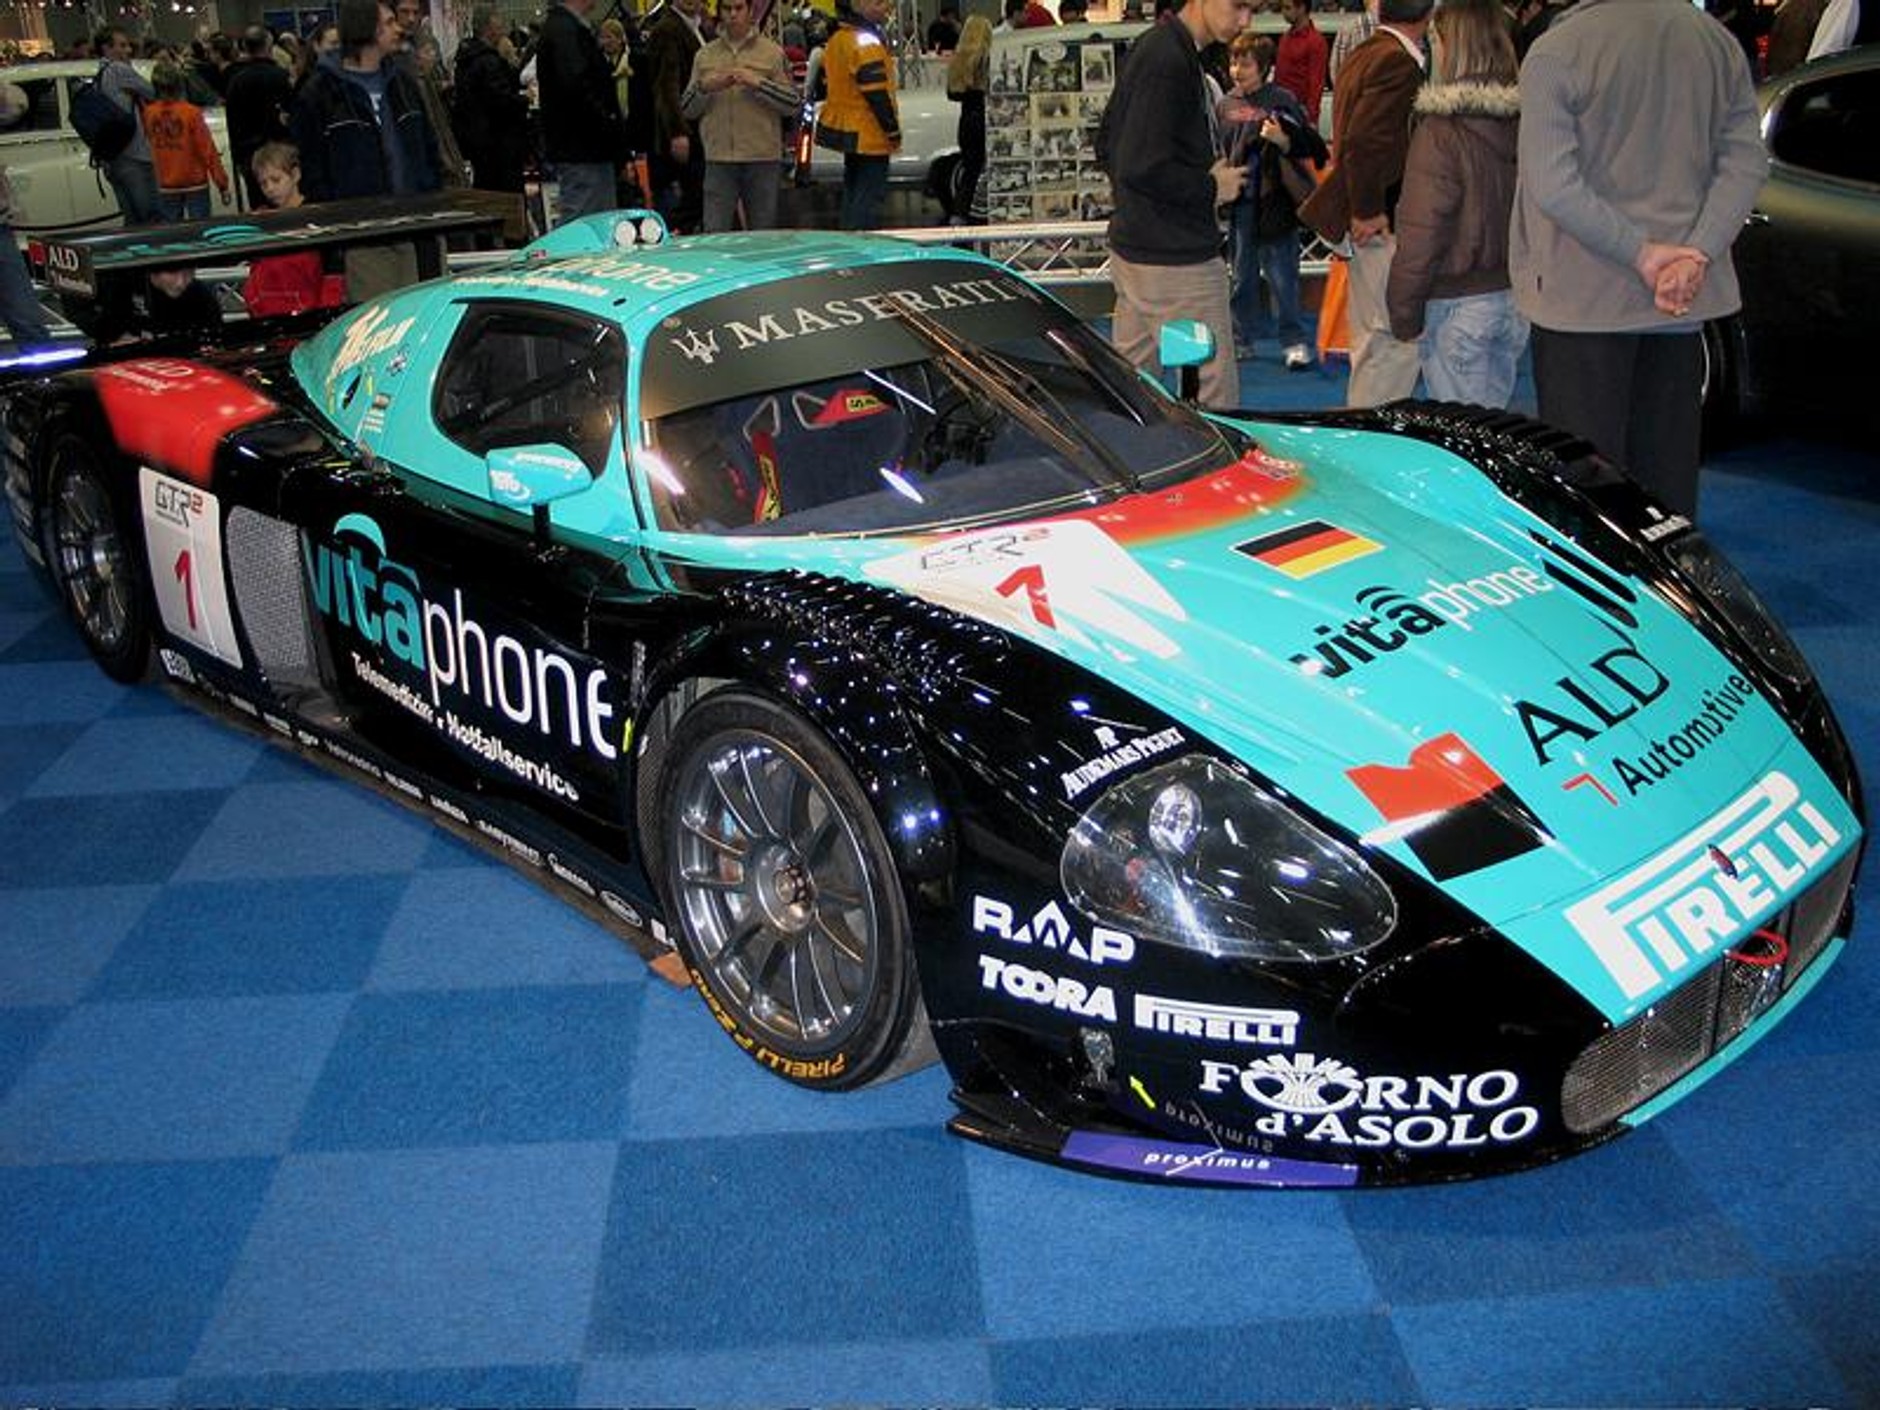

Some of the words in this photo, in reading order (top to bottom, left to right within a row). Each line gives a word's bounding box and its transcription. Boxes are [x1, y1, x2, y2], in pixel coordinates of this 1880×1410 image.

[724, 278, 1015, 351] MASERATI
[174, 549, 197, 631] 1
[994, 564, 1057, 630] 1
[1288, 564, 1556, 680] vitaphone
[301, 513, 618, 760] vitaphone
[1513, 647, 1671, 767] ALD
[1611, 673, 1756, 797] Automotive
[1562, 769, 1843, 1000] PIRELLI
[979, 954, 1118, 1022] TOORA
[1134, 993, 1301, 1046] PIRELLI
[755, 1047, 846, 1079] PIRELLI
[1143, 1152, 1271, 1170] proximus
[1255, 1106, 1540, 1149] d'ASOLO
